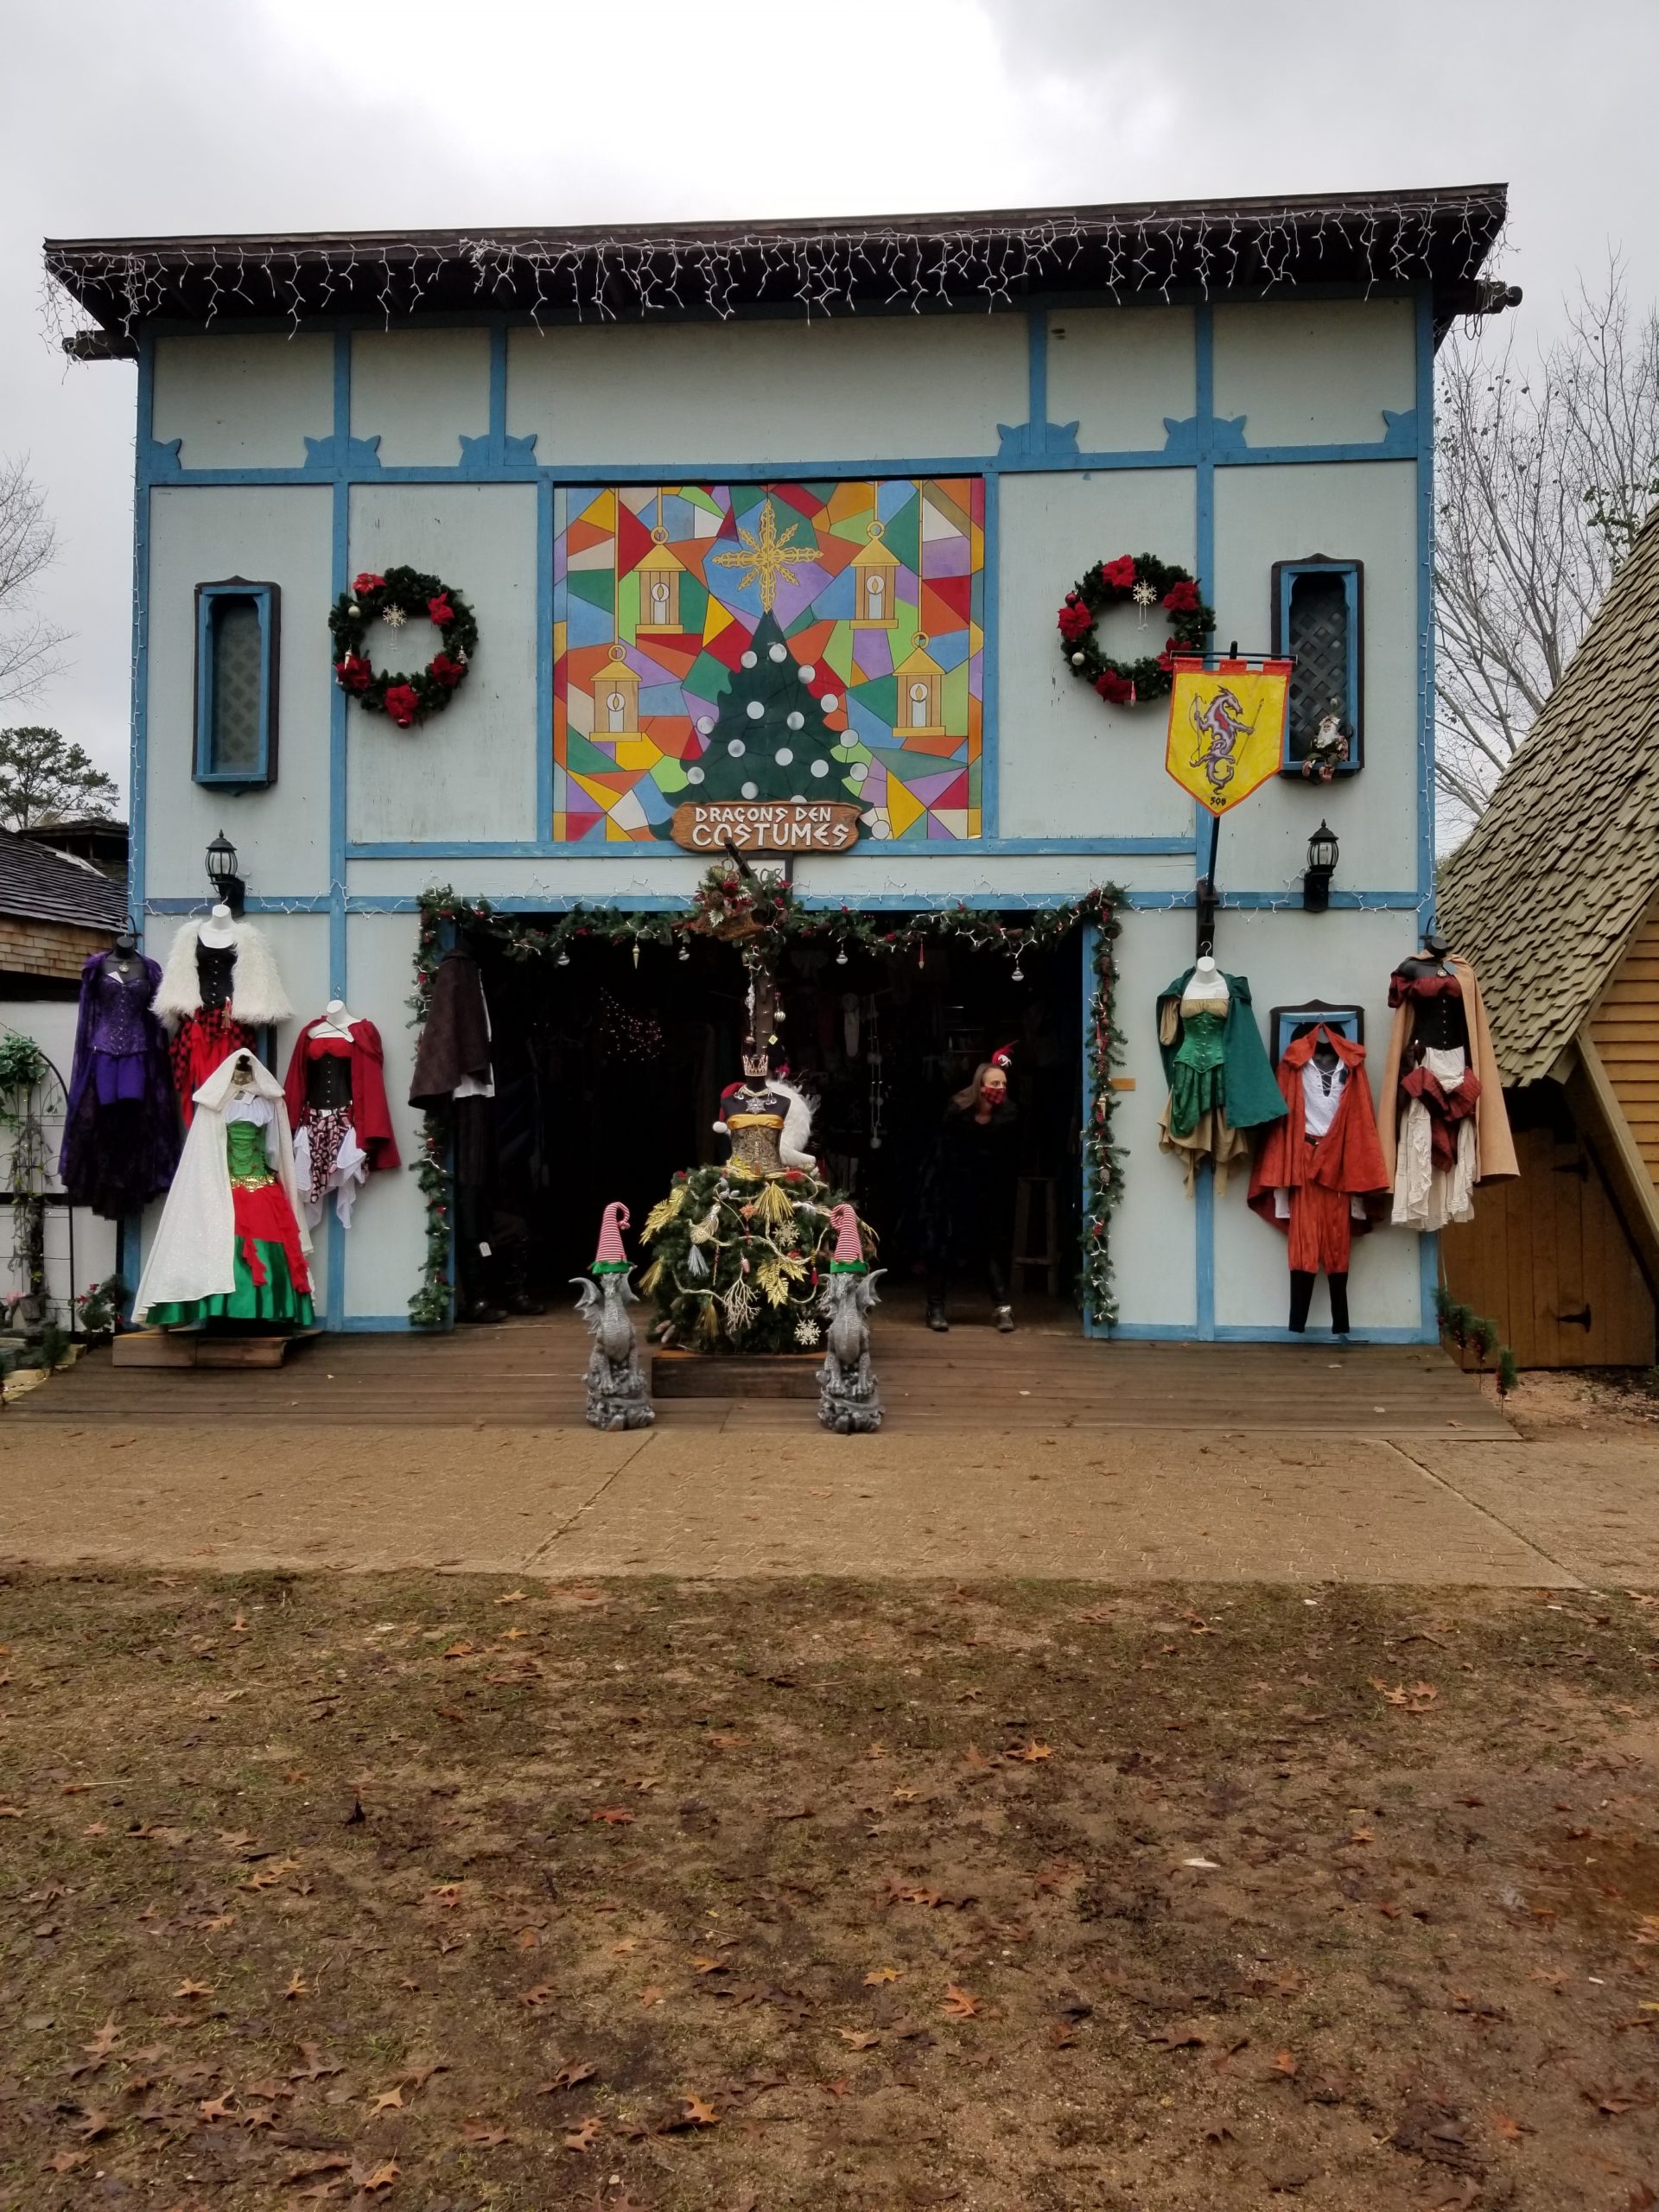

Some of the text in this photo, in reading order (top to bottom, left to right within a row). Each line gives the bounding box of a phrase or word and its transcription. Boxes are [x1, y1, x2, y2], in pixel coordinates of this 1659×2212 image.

[696, 806, 831, 823] DRAGONS DEN
[692, 823, 849, 847] COSTUMES
